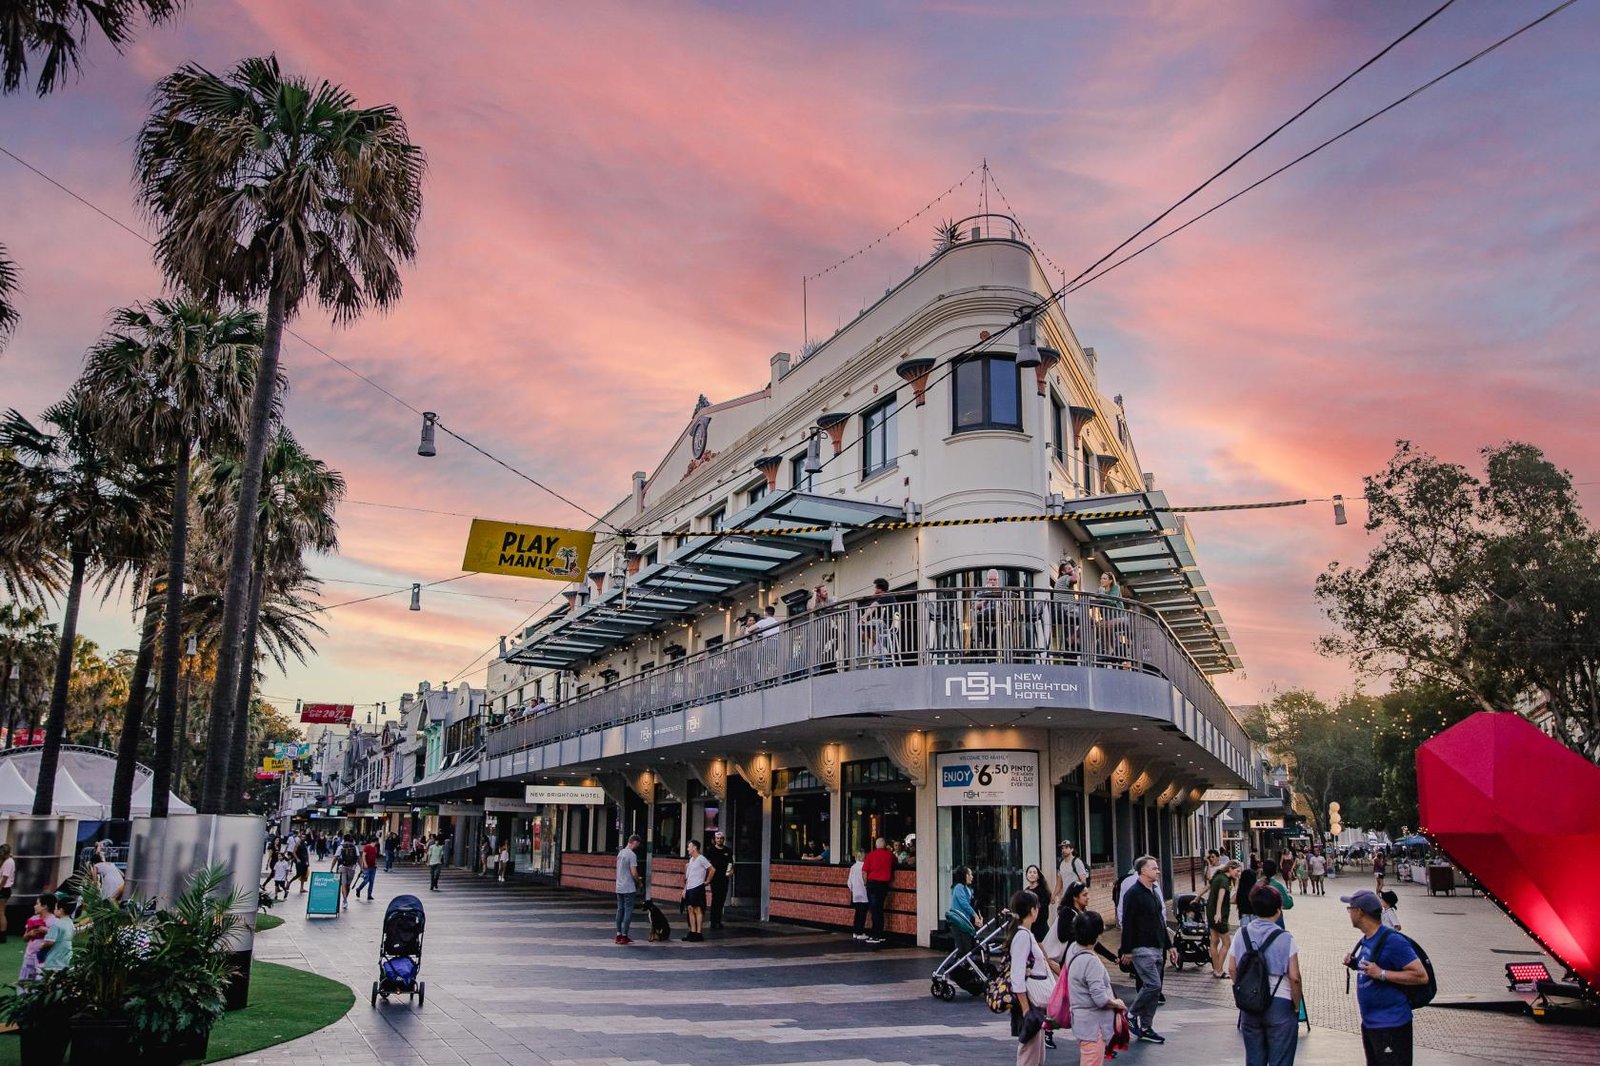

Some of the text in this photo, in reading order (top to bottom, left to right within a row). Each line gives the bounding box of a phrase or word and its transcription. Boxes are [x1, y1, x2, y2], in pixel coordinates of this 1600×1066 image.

[501, 531, 560, 554] PLAY
[498, 553, 555, 570] MANLY
[1014, 673, 1042, 681] NEW
[1014, 682, 1078, 692] BRIGHTON
[1015, 692, 1055, 700] HOTEL
[944, 770, 971, 782] ENJOY
